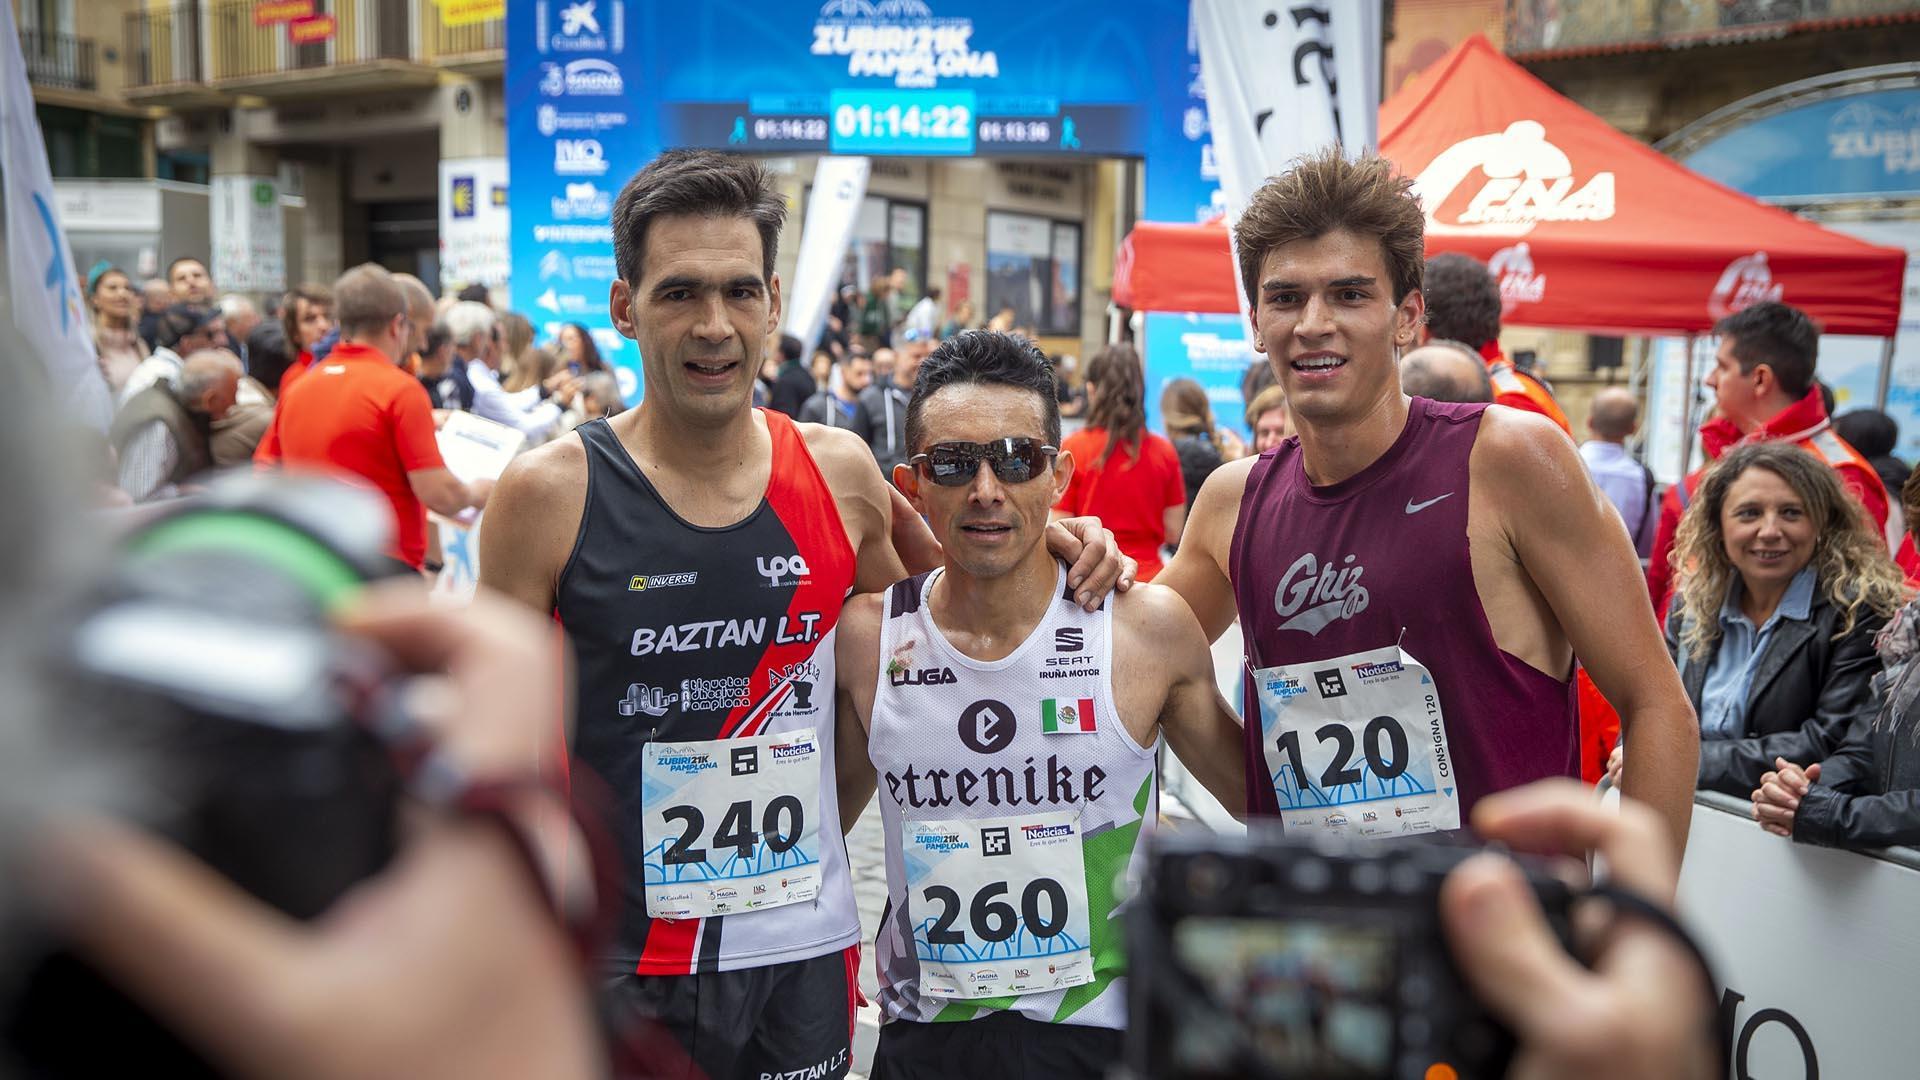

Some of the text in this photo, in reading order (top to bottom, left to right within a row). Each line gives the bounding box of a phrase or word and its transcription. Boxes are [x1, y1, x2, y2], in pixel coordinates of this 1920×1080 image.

[848, 50, 999, 77] PAMPLONA
[834, 104, 971, 138] 01:14:22
[650, 573, 696, 587] INVERSE
[1275, 552, 1369, 620] Griz
[630, 614, 821, 657] BAZTAN L.T.
[1045, 656, 1094, 666] SEAT
[890, 666, 958, 687] LUGA
[1039, 668, 1100, 679] IRUÑA MOTOR
[1358, 663, 1398, 678] Noticias
[680, 677, 750, 691] Etiquetas
[1274, 686, 1308, 696] PAMPLONA
[681, 698, 750, 712] Pamplona
[768, 710, 783, 718] Taller
[1425, 694, 1449, 778] CONSIGNA 120
[775, 745, 810, 757] Noticias
[1276, 715, 1409, 790] 120
[670, 762, 718, 772] PAMPLONA
[661, 795, 804, 866] 240
[1028, 826, 1068, 839] Noticias
[925, 842, 970, 850] PAMPLONA
[922, 878, 1069, 945] 260
[1015, 968, 1030, 977] IMQ
[830, 1048, 846, 1072] L.T.
